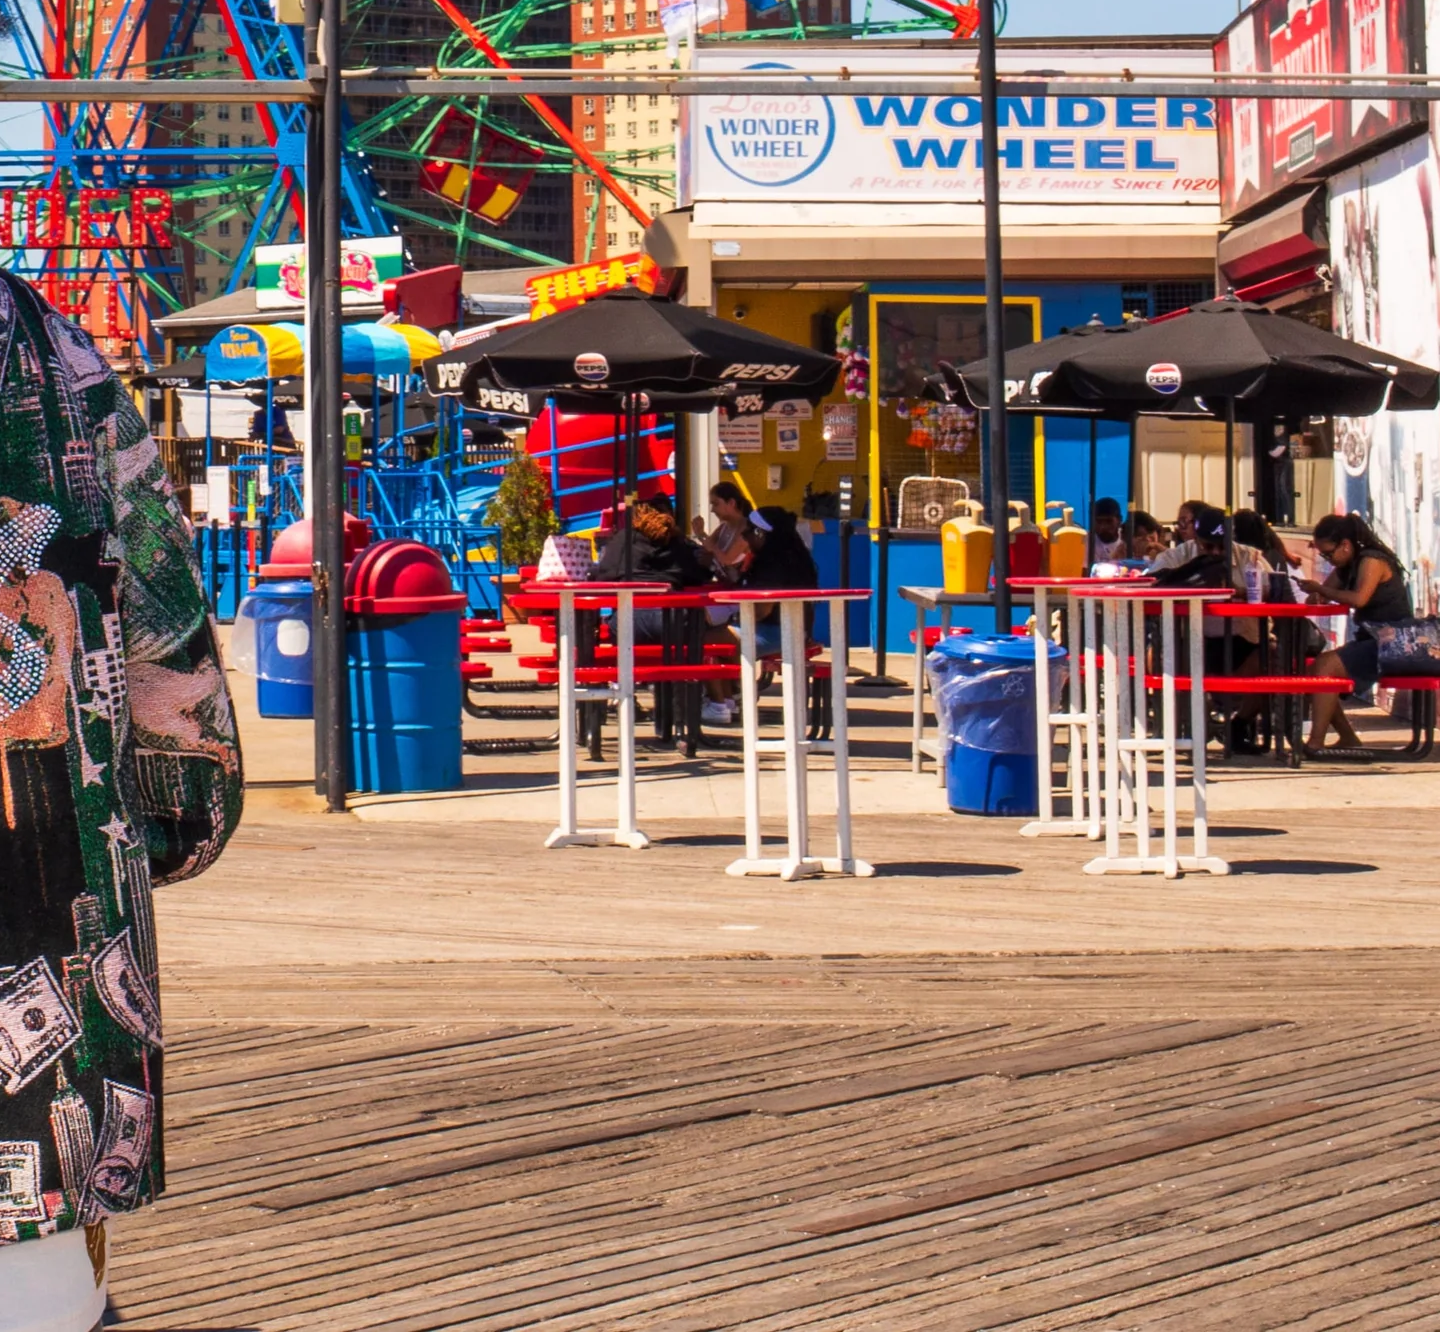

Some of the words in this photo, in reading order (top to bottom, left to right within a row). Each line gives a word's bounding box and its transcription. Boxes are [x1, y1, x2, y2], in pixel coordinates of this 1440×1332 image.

[854, 95, 1216, 129] WONDER
[720, 118, 820, 136] WONDER
[731, 140, 809, 158] WHEEL
[892, 138, 1177, 170] WHEEL
[849, 177, 864, 189] A
[871, 177, 925, 189] PLACE
[933, 179, 966, 189] FOR
[973, 177, 1011, 190] FN
[1038, 177, 1105, 190] FAMILY
[1113, 178, 1166, 191] SINCE
[1172, 178, 1221, 191] 1920
[576, 364, 608, 373] PEPSI
[719, 363, 801, 381] PEPSI
[480, 388, 531, 414] PEPSI
